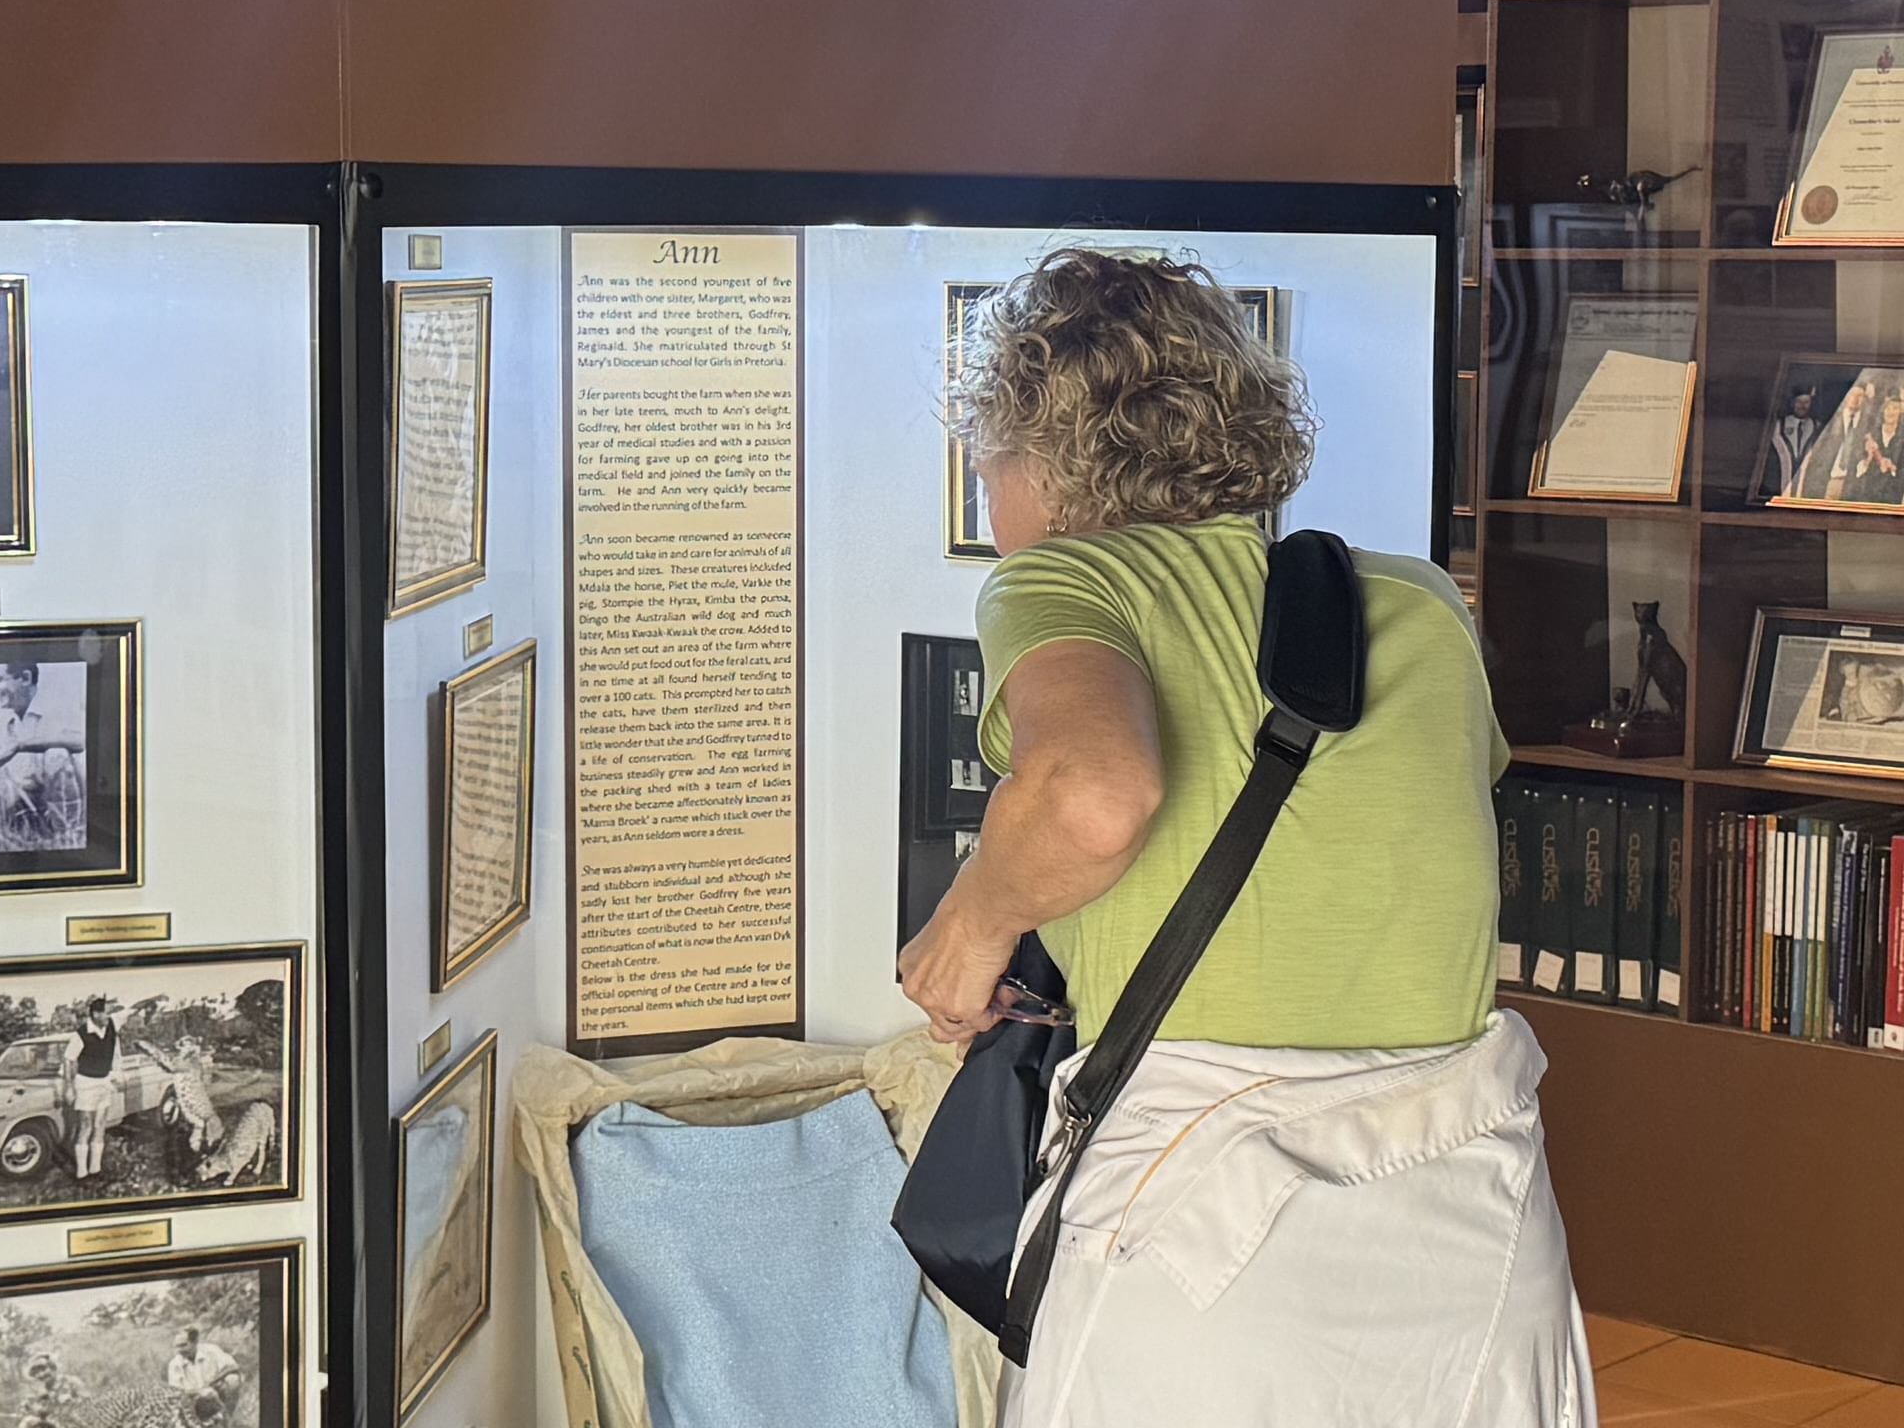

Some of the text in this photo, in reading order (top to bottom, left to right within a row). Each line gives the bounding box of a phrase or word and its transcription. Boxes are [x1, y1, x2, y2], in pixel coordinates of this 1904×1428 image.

[652, 239, 720, 264] Ann
[577, 274, 792, 289] Ann was the second youngest of five
[577, 340, 627, 353] Reginald.
[632, 340, 653, 352] She
[658, 340, 727, 351] matriculated
[733, 340, 776, 352] through
[602, 390, 641, 401] parents
[642, 389, 678, 401] bought
[680, 388, 697, 399] the
[699, 388, 722, 399] farm
[723, 388, 752, 398] when
[753, 389, 770, 398] she
[772, 390, 791, 398] was
[579, 708, 597, 719] the
[631, 706, 656, 716] have
[661, 705, 688, 715] them
[693, 702, 739, 714] sterilized
[743, 701, 763, 712] and
[768, 701, 791, 710] then
